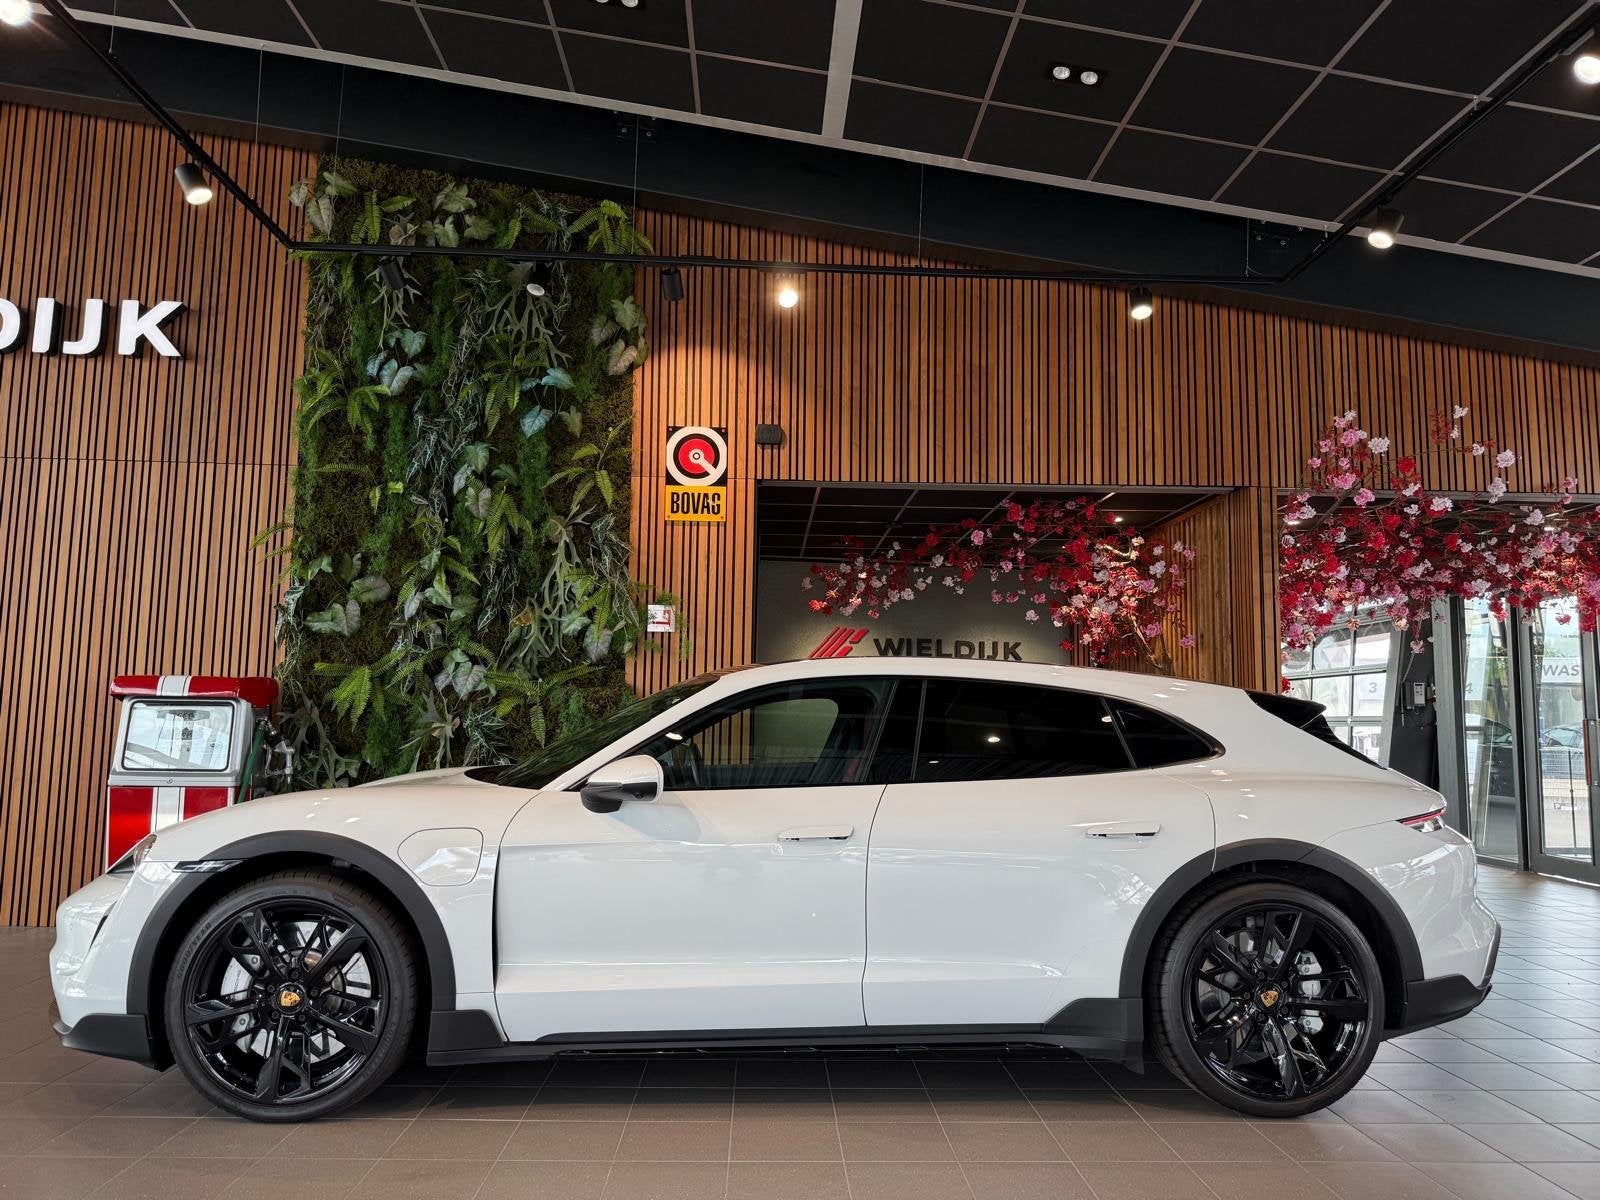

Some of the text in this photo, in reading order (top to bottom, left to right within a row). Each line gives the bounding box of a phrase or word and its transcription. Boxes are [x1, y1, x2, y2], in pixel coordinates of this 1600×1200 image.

[670, 491, 721, 515] BOVAG
[873, 637, 1022, 661] WIELDIJK
[1368, 682, 1378, 694] 3
